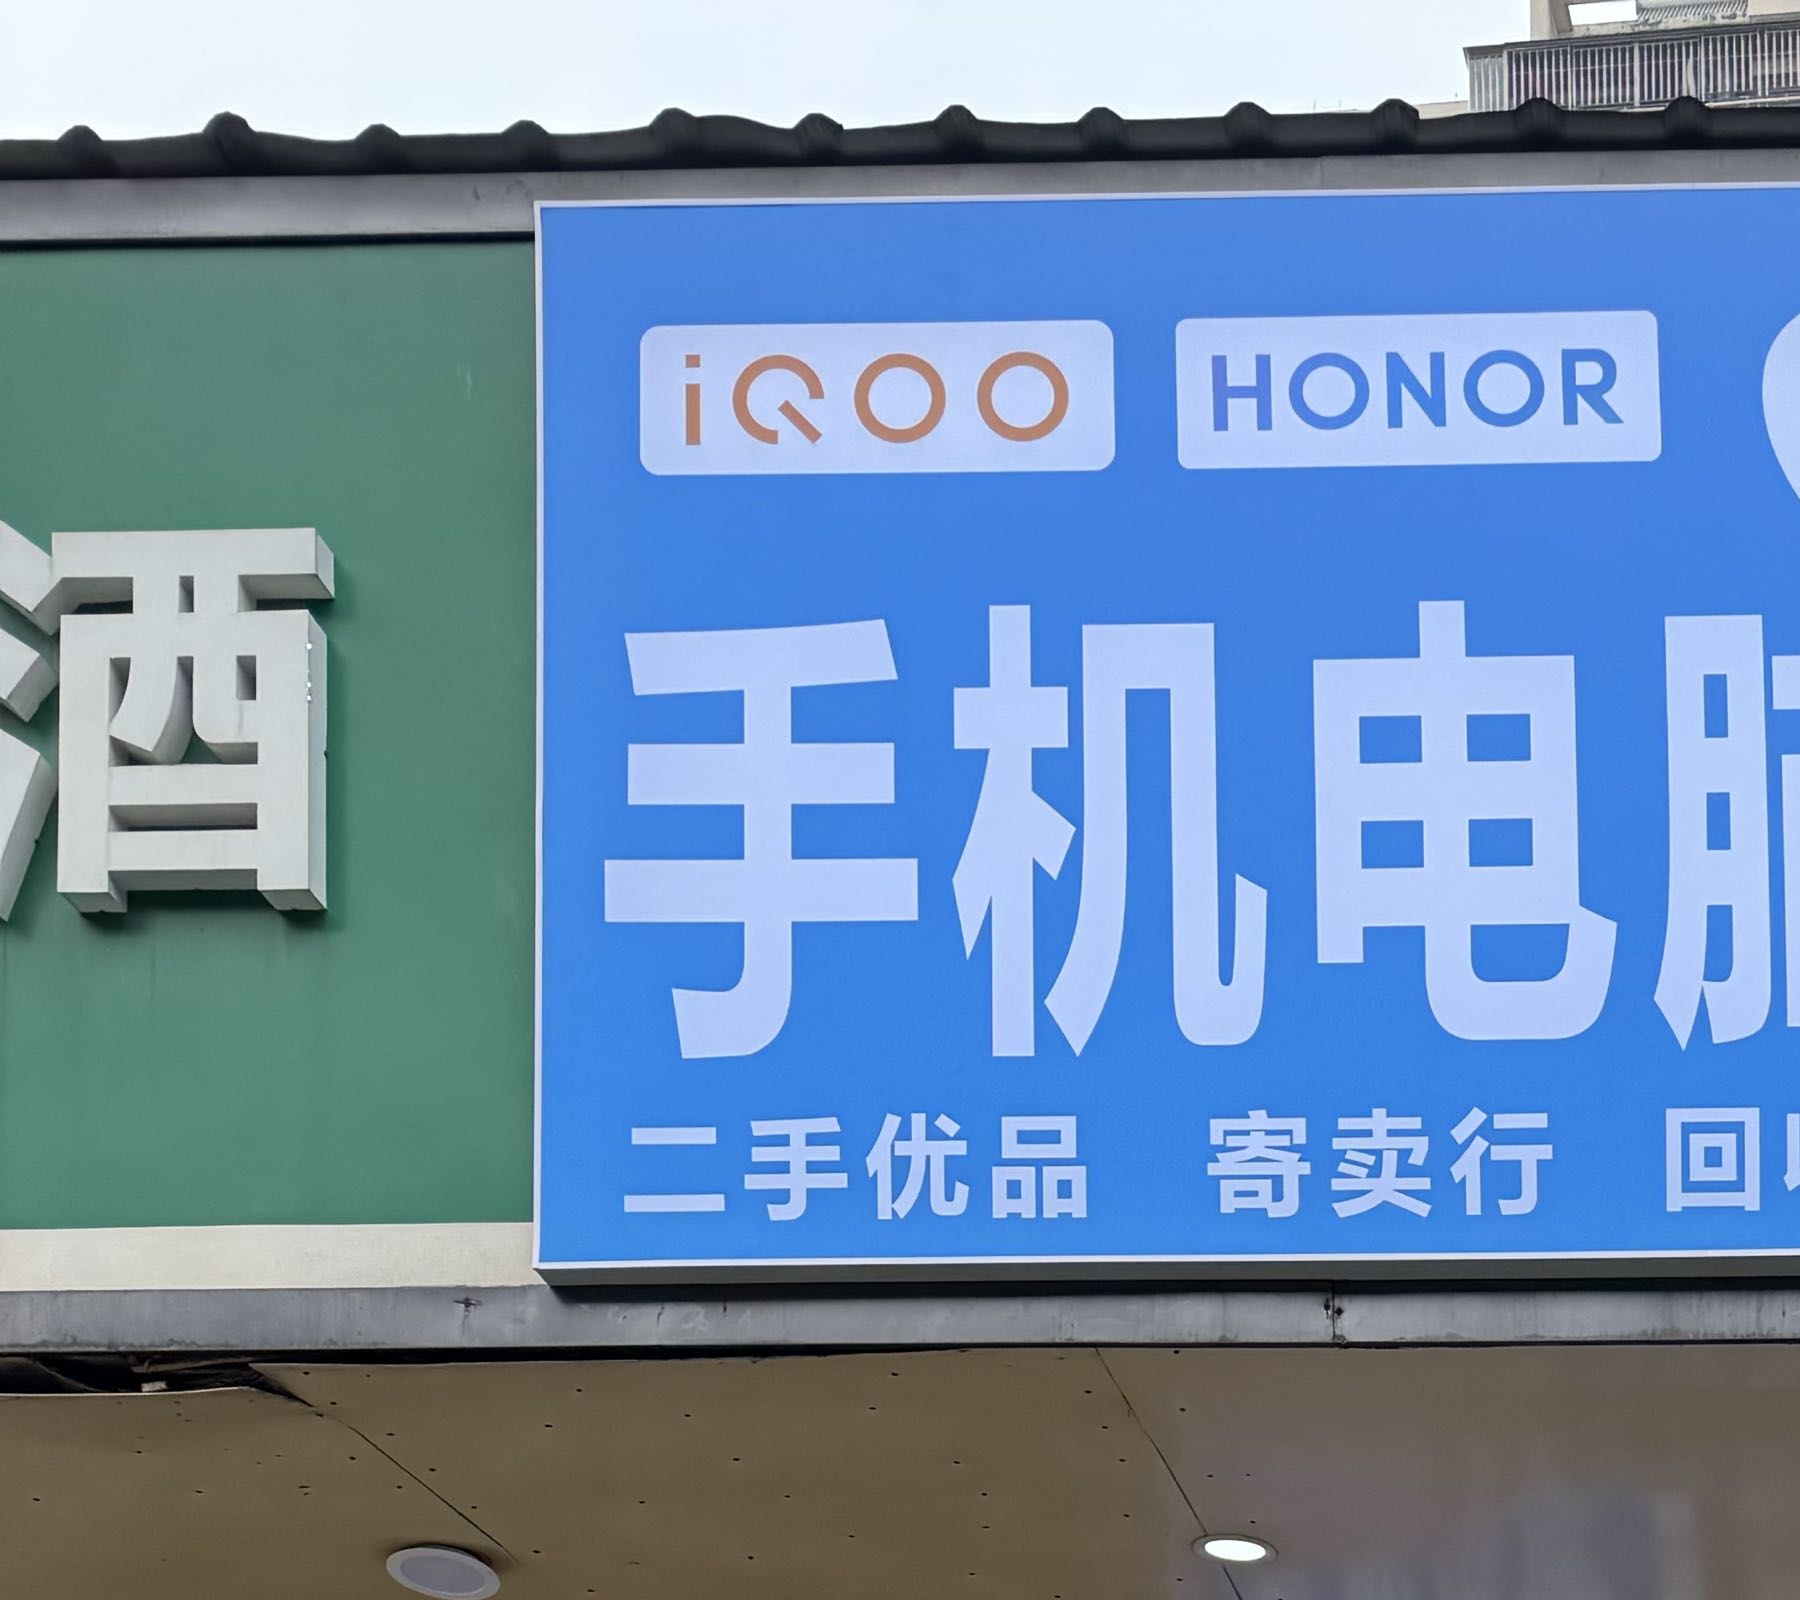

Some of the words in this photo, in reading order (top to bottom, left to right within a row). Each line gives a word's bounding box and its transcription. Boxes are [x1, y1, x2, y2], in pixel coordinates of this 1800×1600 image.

[1210, 346, 1625, 430] HONOR
[622, 1108, 1088, 1220] 二手优品
[1208, 1105, 1553, 1217] 寄卖行
